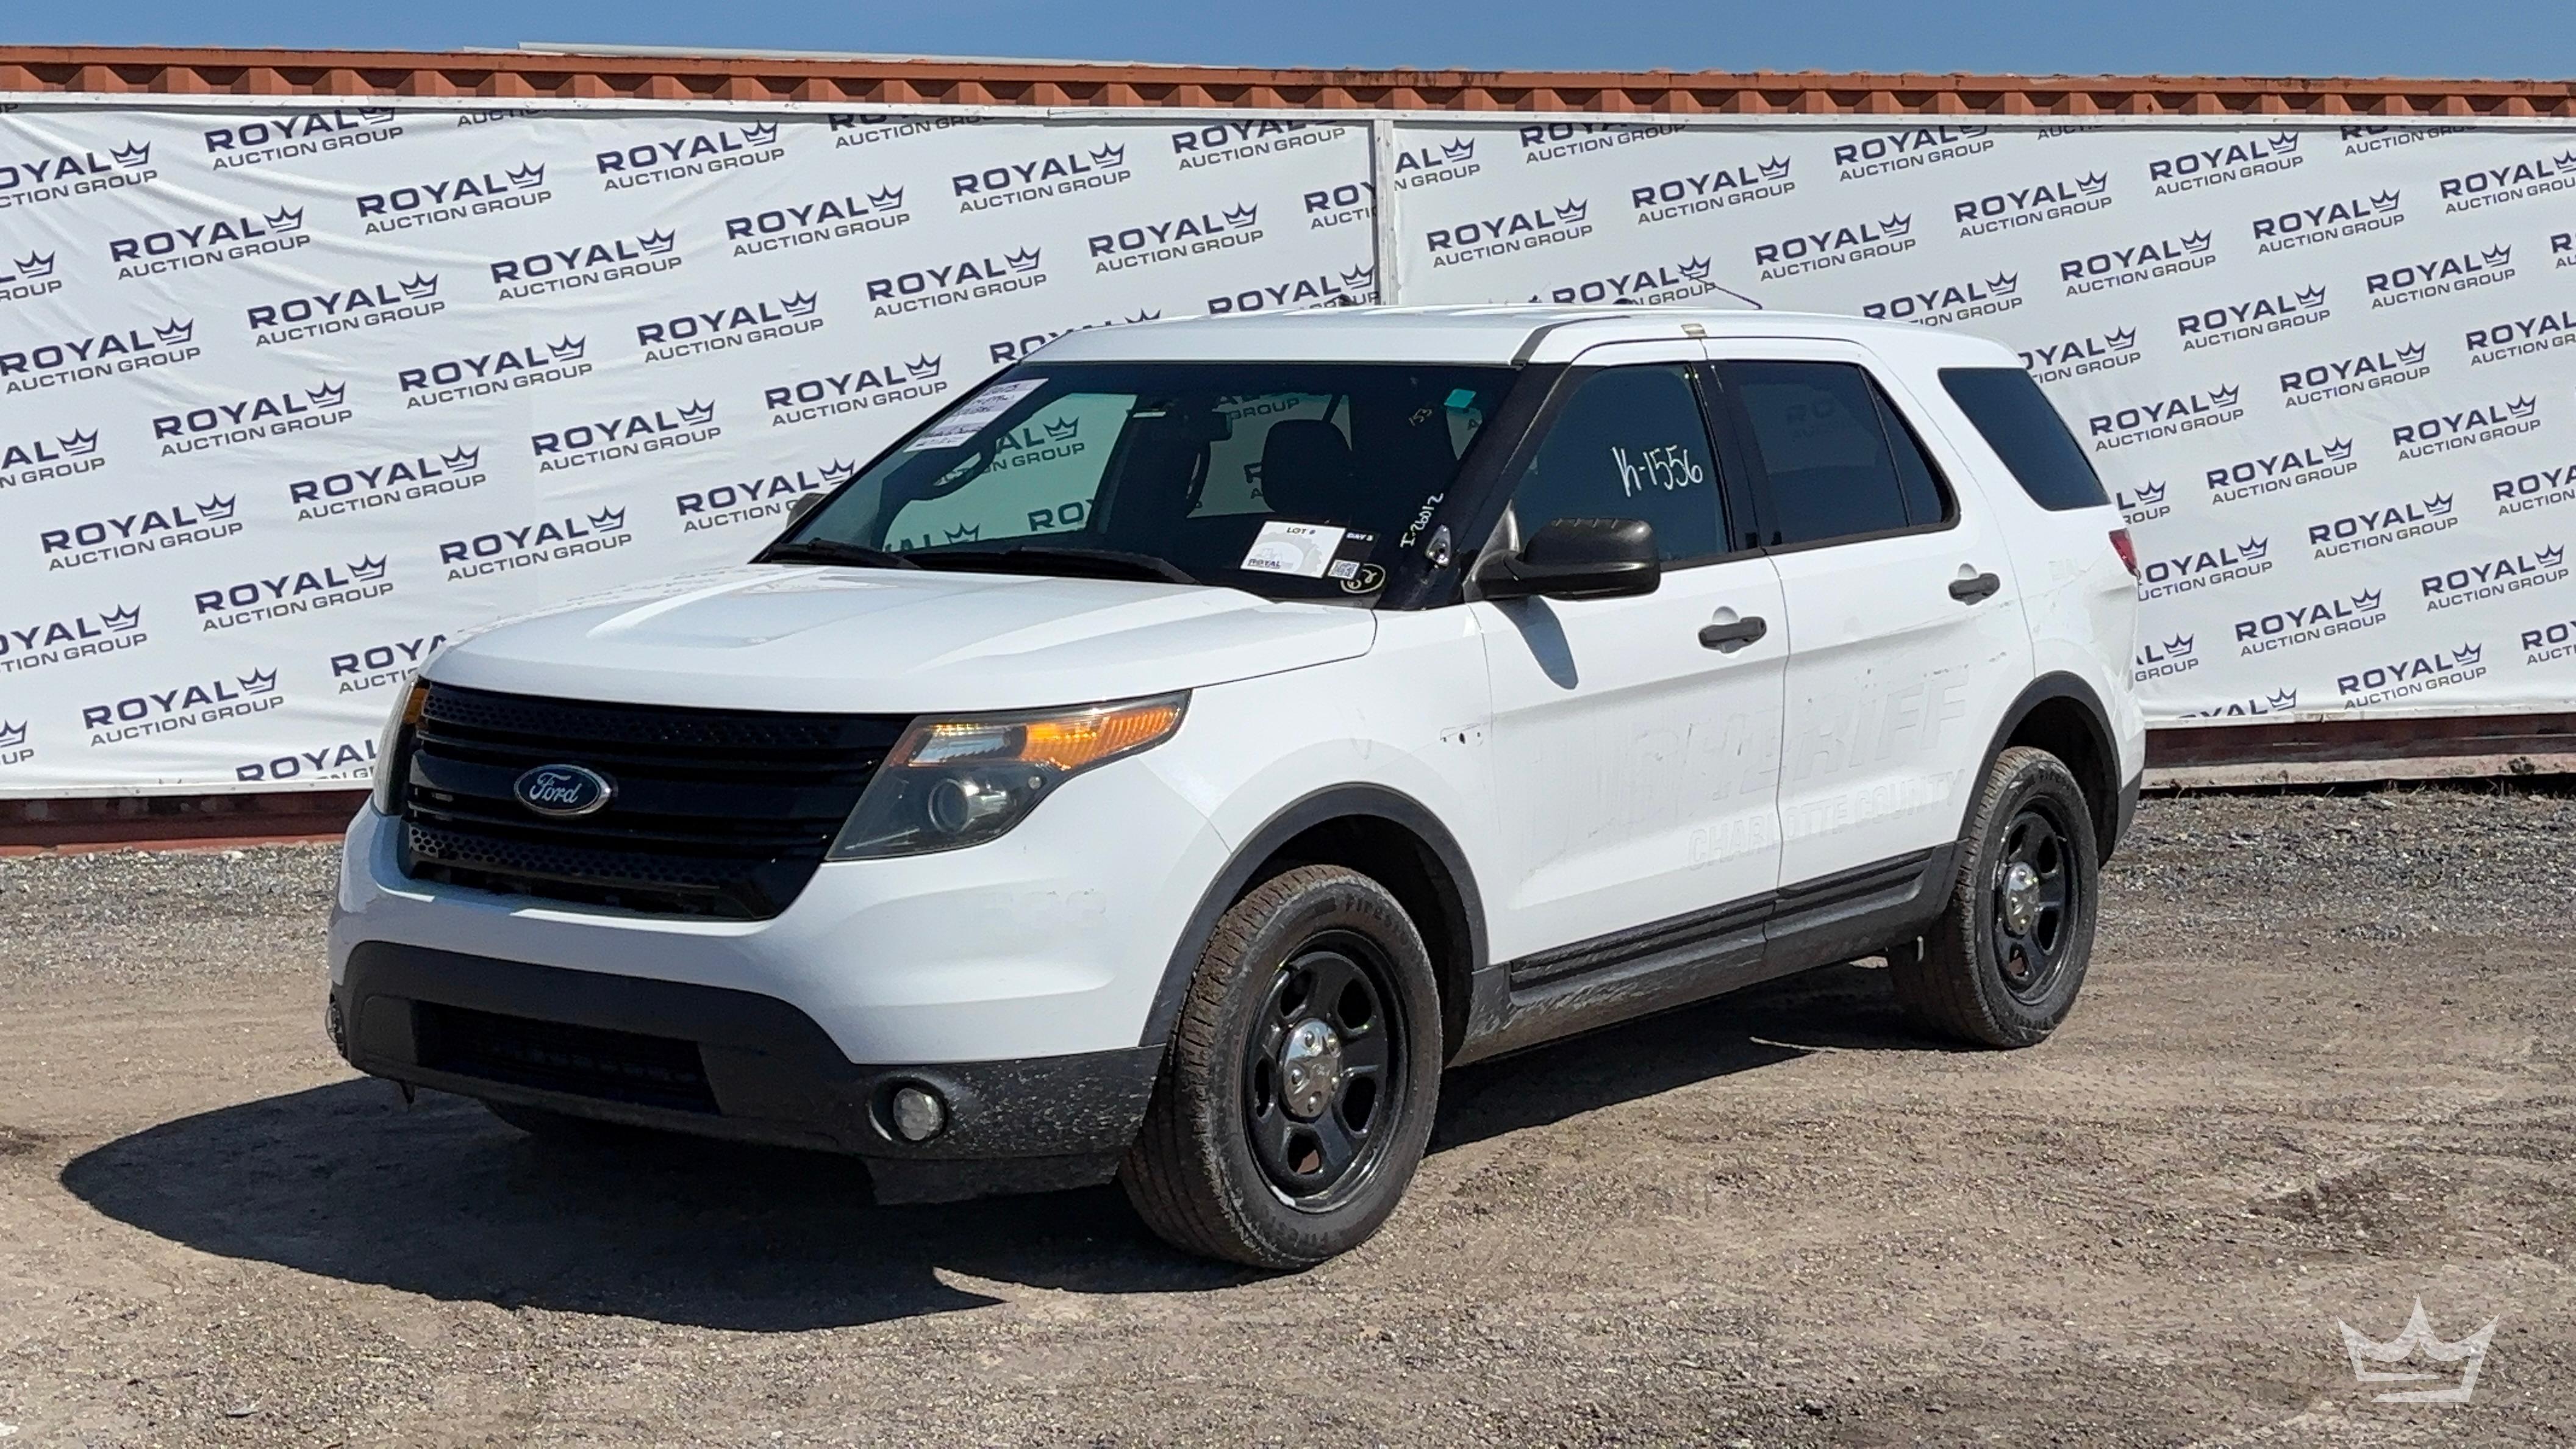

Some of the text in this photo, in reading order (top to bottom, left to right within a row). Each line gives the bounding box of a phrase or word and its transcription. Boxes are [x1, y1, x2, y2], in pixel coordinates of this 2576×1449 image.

[204, 109, 359, 153] ROYAL
[213, 126, 404, 171] AUCTION GROUP
[596, 131, 743, 174] ROYAL
[835, 120, 931, 149] AUCTION
[1178, 127, 1346, 171] AUCTION GROUP
[1526, 136, 1614, 164] AUCTION
[1833, 125, 1959, 166] ROYAL
[2344, 131, 2425, 156] AUCTION
[74, 170, 157, 195] GROUP
[604, 148, 785, 191] AUCTION GROUP
[952, 154, 1092, 197] ROYAL
[1411, 163, 1481, 188] GROUP
[1839, 140, 1995, 182] AUCTION GROUP
[2149, 140, 2269, 182] ROYAL
[2155, 156, 2303, 196] AUCTION GROUP
[2440, 160, 2555, 199] ROYAL
[356, 174, 509, 218] ROYAL
[960, 170, 1131, 213] AUCTION GROUP
[1631, 166, 1759, 209] ROYAL
[1638, 182, 1795, 225] AUCTION GROUP
[1954, 182, 2077, 223] ROYAL
[2445, 188, 2524, 214] AUCTION
[365, 190, 551, 235] AUCTION GROUP
[725, 196, 870, 240] ROYAL
[1426, 209, 1556, 252] ROYAL
[1959, 196, 2112, 238] AUCTION GROUP
[2252, 199, 2371, 240] ROYAL
[109, 217, 267, 263] ROYAL
[734, 213, 910, 257] AUCTION GROUP
[1088, 214, 1225, 258] ROYAL
[1095, 230, 1264, 274] AUCTION GROUP
[1433, 225, 1593, 268] AUCTION GROUP
[1755, 224, 1880, 266] ROYAL
[2258, 214, 2405, 255] AUCTION GROUP
[118, 235, 311, 281] AUCTION GROUP
[490, 240, 640, 284] ROYAL
[499, 257, 682, 301] AUCTION GROUP
[1761, 238, 1916, 282] AUCTION GROUP
[2060, 240, 2182, 282] ROYAL
[2066, 255, 2216, 297] AUCTION GROUP
[2366, 254, 2483, 295] ROYAL
[866, 258, 1007, 302] ROYAL
[874, 273, 1047, 318] AUCTION GROUP
[1648, 282, 1716, 306] GROUP
[2372, 268, 2516, 309] AUCTION GROUP
[246, 284, 401, 330] ROYAL
[256, 301, 445, 347] AUCTION GROUP
[636, 302, 782, 347] ROYAL
[1956, 297, 2023, 321] GROUP
[2177, 295, 2297, 337] ROYAL
[645, 318, 824, 363] AUCTION GROUP
[2183, 309, 2330, 352] AUCTION GROUP
[0, 330, 156, 377] ROYAL
[6, 347, 201, 395] AUCTION GROUP
[398, 346, 549, 392] ROYAL
[2075, 352, 2141, 375] GROUP
[2280, 352, 2397, 393] ROYAL
[2470, 339, 2549, 367] AUCTION
[407, 363, 592, 409] AUCTION GROUP
[764, 365, 907, 410] ROYAL
[772, 381, 948, 427] AUCTION GROUP
[2286, 366, 2430, 409] AUCTION GROUP
[152, 393, 308, 440] ROYAL
[161, 409, 352, 457] AUCTION GROUP
[531, 411, 679, 456] ROYAL
[2089, 395, 2210, 437] ROYAL
[2095, 409, 2244, 452] AUCTION GROUP
[2392, 405, 2508, 446] ROYAL
[540, 427, 721, 473] AUCTION GROUP
[1011, 442, 1085, 467] GROUP
[2398, 419, 2541, 461] AUCTION GROUP
[21, 457, 106, 484] GROUP
[289, 457, 443, 504] ROYAL
[2206, 448, 2324, 490] ROYAL
[2212, 462, 2357, 505] AUCTION GROUP
[298, 474, 486, 521] AUCTION GROUP
[676, 471, 820, 516] ROYAL
[2498, 488, 2575, 516] AUCTION
[40, 506, 198, 554] ROYAL
[684, 503, 781, 533] AUCTION
[2308, 503, 2425, 545] ROYAL
[2314, 517, 2458, 560] AUCTION GROUP
[49, 522, 243, 571] AUCTION GROUP
[439, 518, 590, 565] ROYAL
[448, 534, 632, 581] AUCTION GROUP
[195, 567, 349, 615] ROYAL
[2138, 561, 2273, 601] UCTION GROUP
[2421, 555, 2536, 597] ROYAL
[2427, 568, 2569, 612] AUCTION GROUP
[203, 582, 393, 632] AUCTION GROUP
[2234, 599, 2353, 642] ROYAL
[63, 632, 148, 660] GROUP
[2241, 613, 2386, 657] AUCTION GROUP
[2134, 658, 2199, 682] GROUP
[2337, 654, 2453, 696] ROYAL
[2344, 667, 2486, 709] AUCTION GROUP
[82, 681, 240, 730] ROYAL
[91, 696, 284, 747] AUCTION GROUP
[529, 771, 582, 804] Ford
